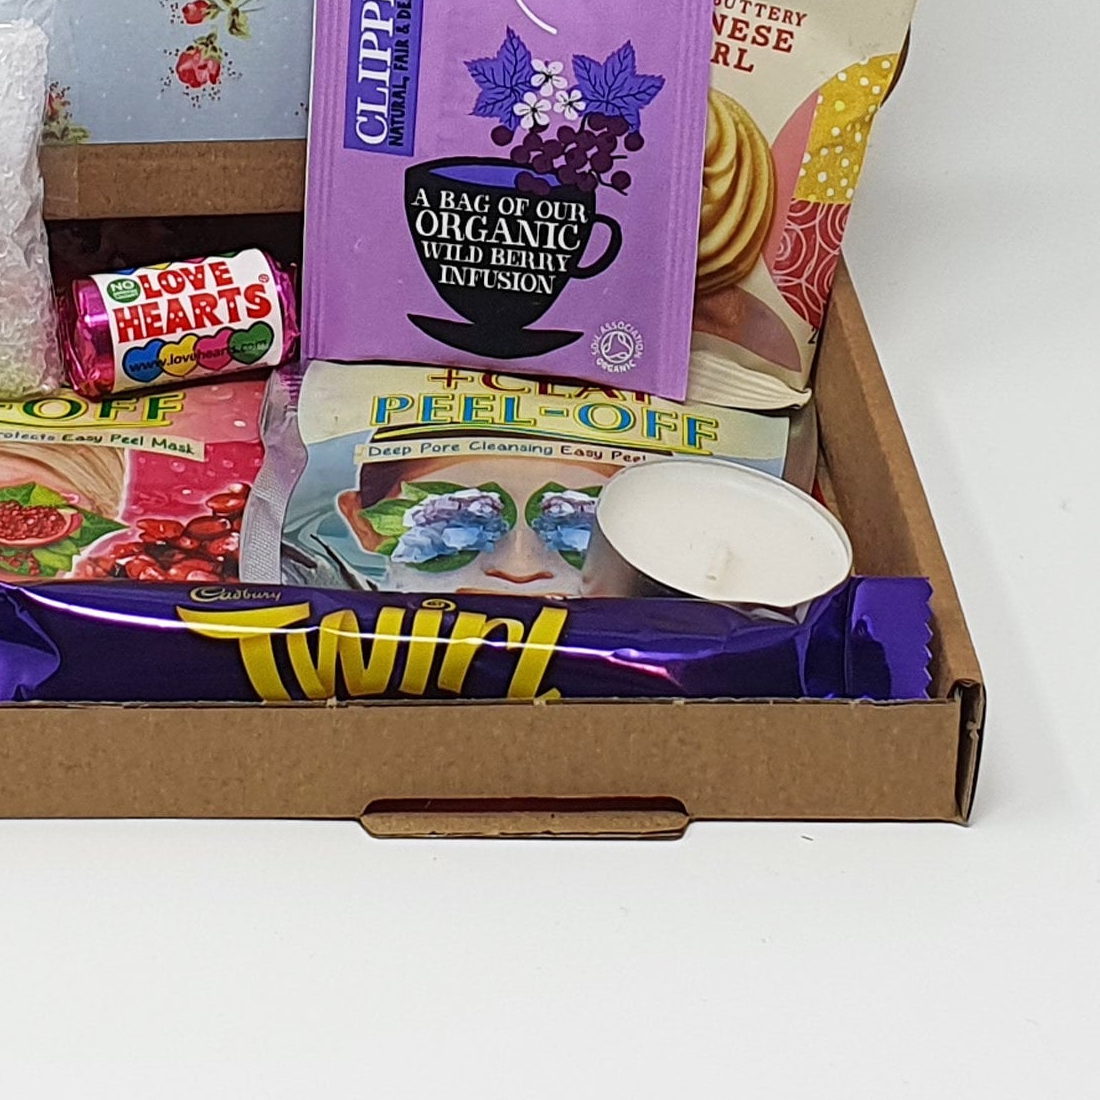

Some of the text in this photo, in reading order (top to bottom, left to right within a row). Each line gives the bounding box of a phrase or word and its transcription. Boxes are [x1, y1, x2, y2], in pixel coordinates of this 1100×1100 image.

[395, 23, 411, 35] &
[393, 38, 410, 73] FAIR
[388, 76, 411, 147] NATURAL,
[410, 188, 589, 224] A BAG OF OUR
[415, 208, 582, 251] ORGANIC
[421, 240, 573, 273] WILD BERRY
[110, 280, 135, 292] NO
[137, 260, 235, 301] LOVE
[437, 264, 557, 295] INFUSION
[370, 391, 719, 450] PEEL-OFF
[61, 433, 103, 444] Easy
[110, 433, 144, 446] Peel
[151, 437, 196, 456] Mask
[367, 445, 411, 458] Deep
[419, 441, 461, 454] Pore
[468, 440, 554, 456] Cleansing
[559, 445, 604, 461] Easy
[189, 585, 282, 602] Cadbury
[176, 597, 570, 701] Twirl
